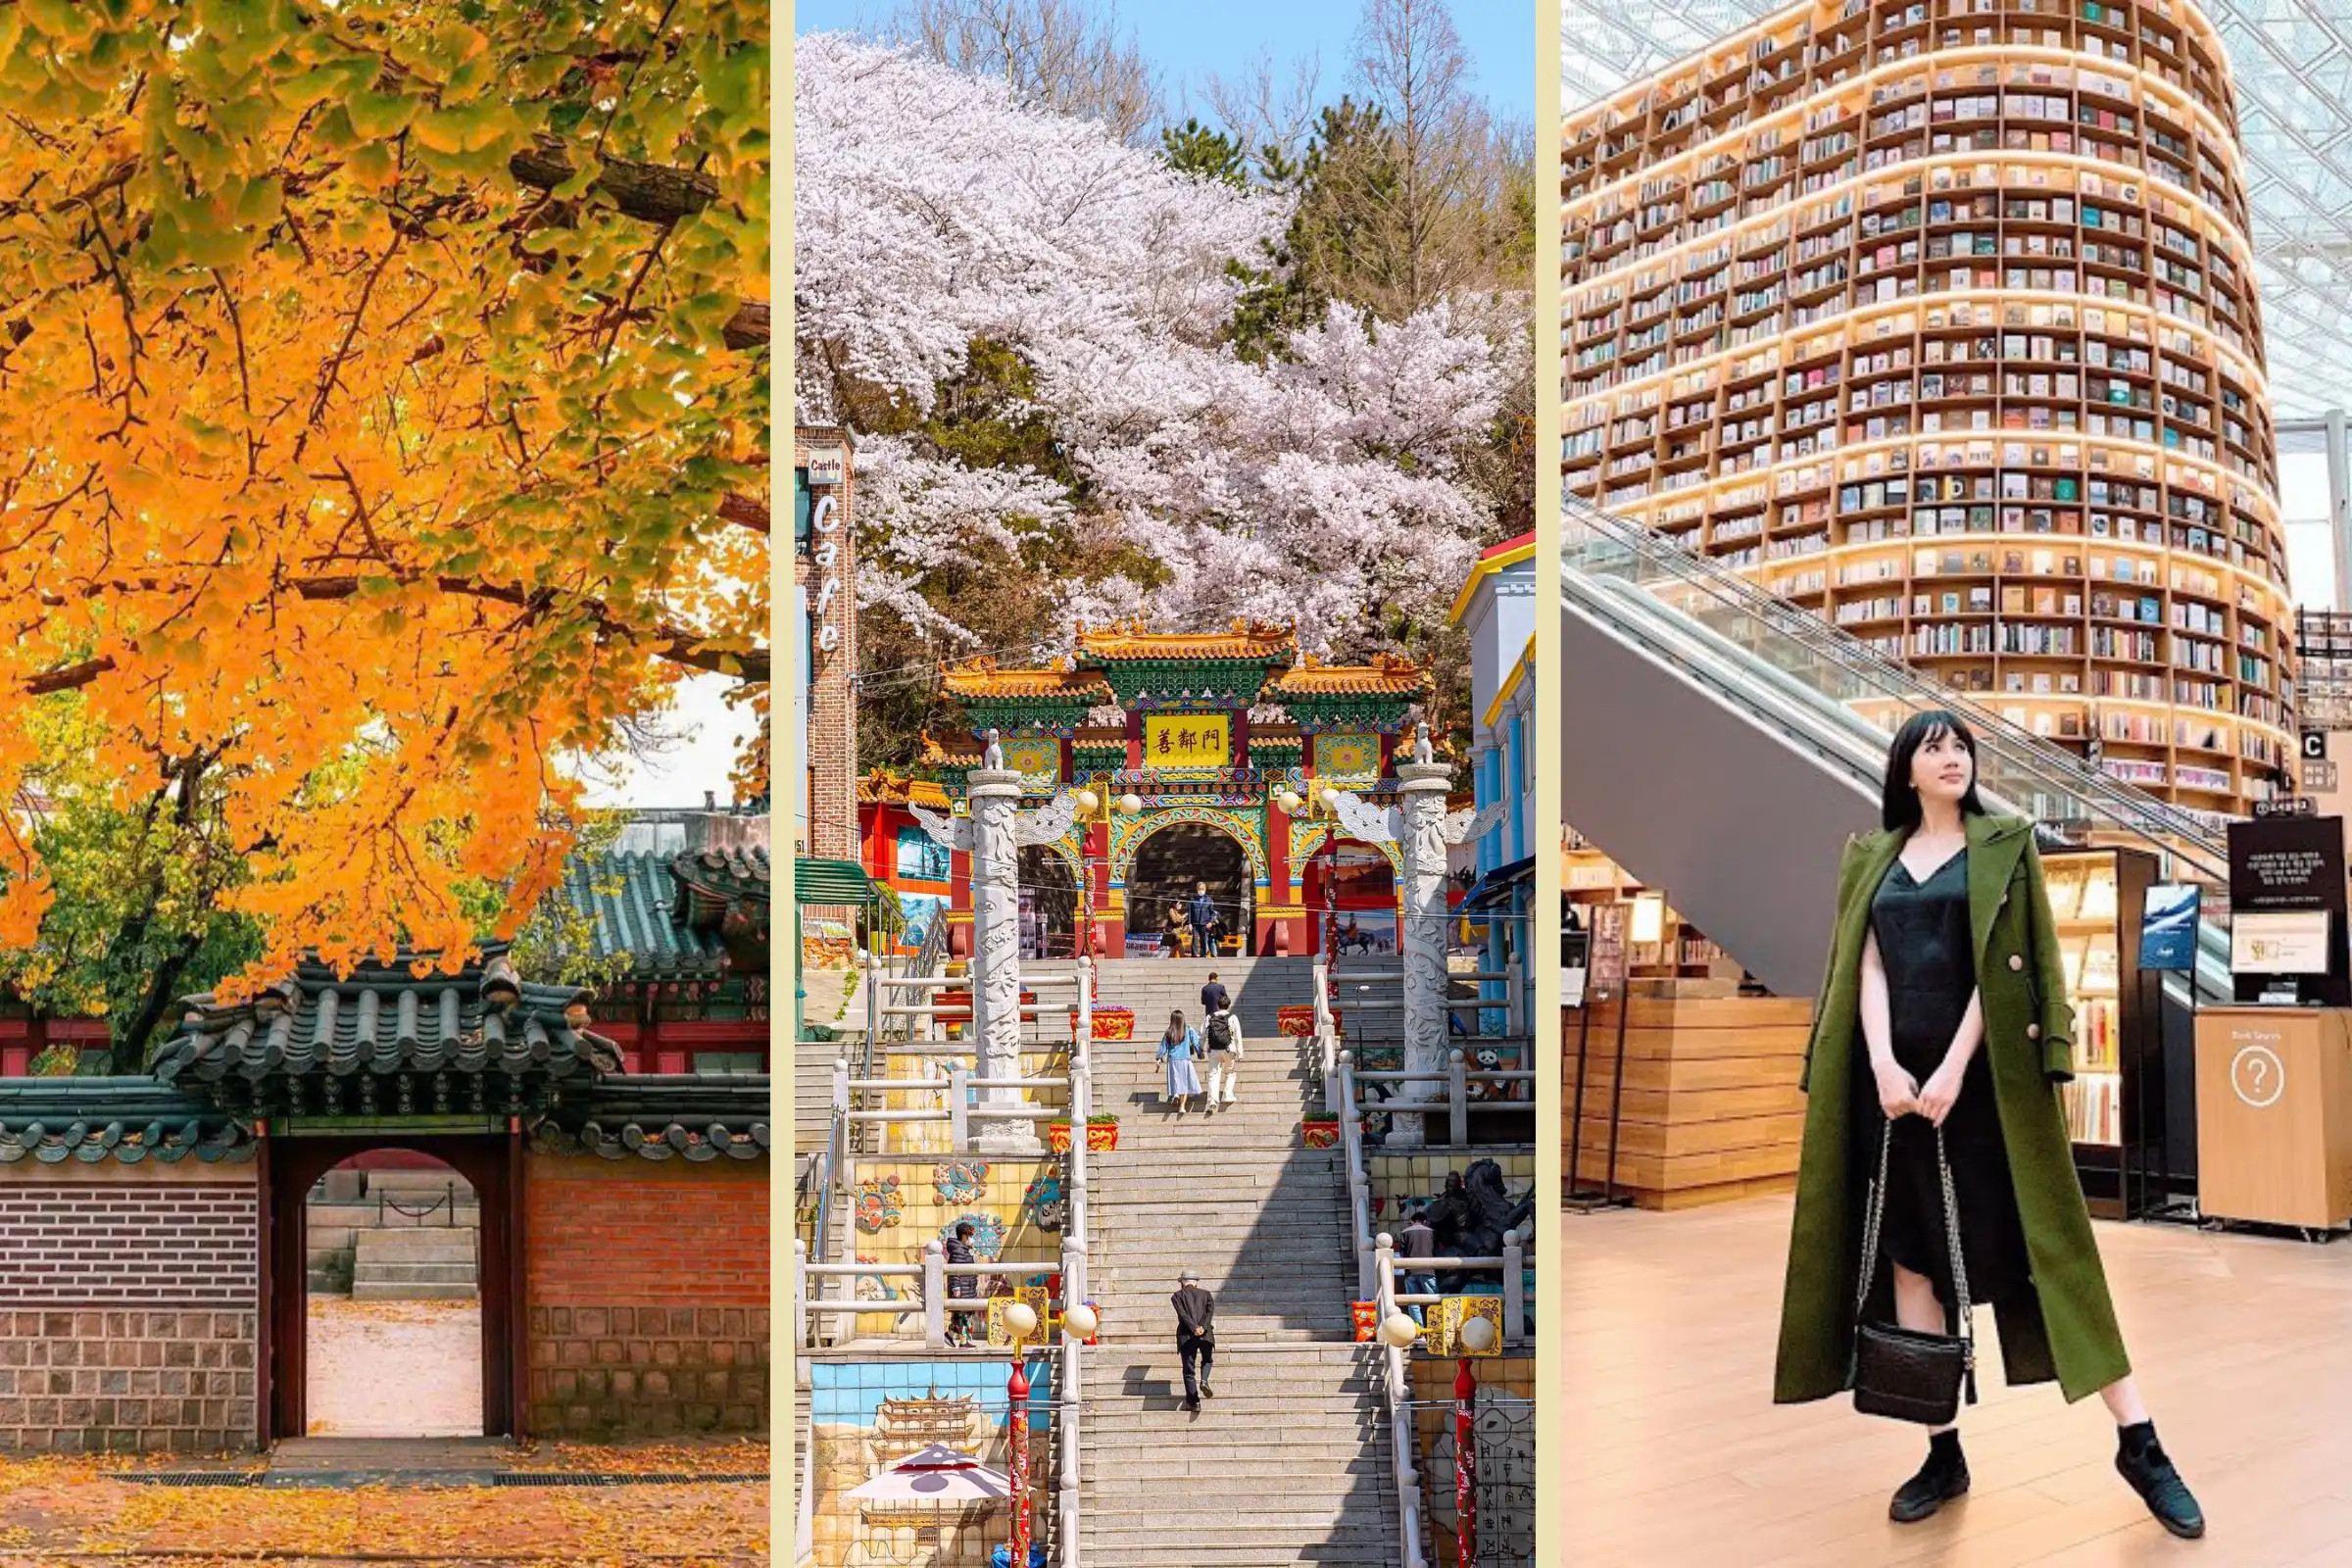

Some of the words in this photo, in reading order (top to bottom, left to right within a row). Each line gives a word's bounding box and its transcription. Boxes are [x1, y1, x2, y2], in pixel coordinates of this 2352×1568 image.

[810, 458, 841, 472] Castle
[813, 495, 841, 651] Cafe
[2305, 735, 2322, 756] C
